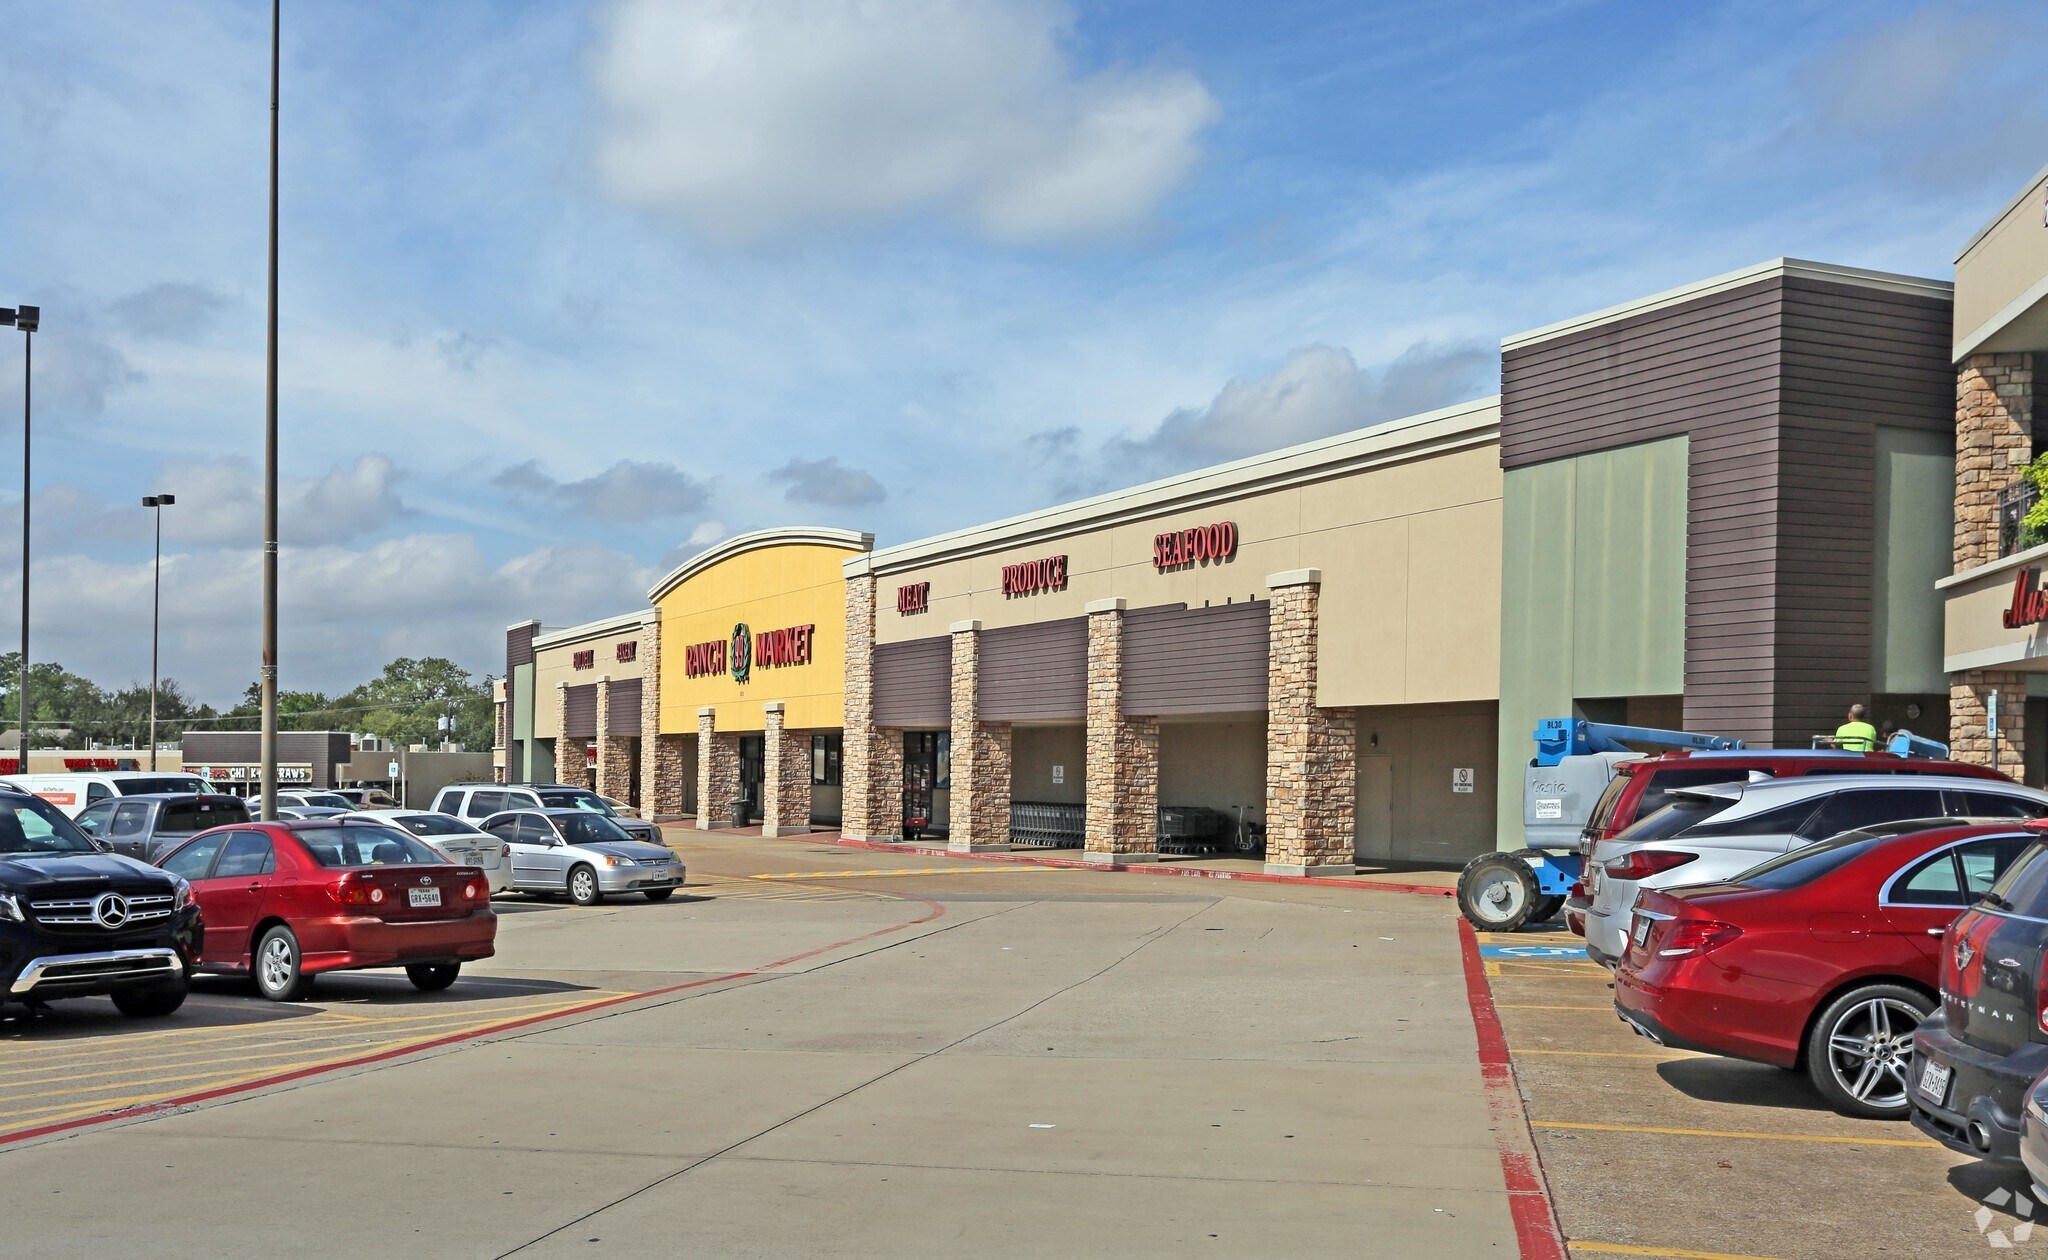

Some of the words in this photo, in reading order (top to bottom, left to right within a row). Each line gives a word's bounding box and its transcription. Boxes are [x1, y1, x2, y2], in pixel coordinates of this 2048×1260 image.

[1153, 521, 1236, 568] SEAFOOD
[1002, 554, 1066, 595] PRODUCE
[897, 582, 927, 612] MEAT
[685, 640, 725, 676] RANCH
[734, 635, 743, 668] 99
[756, 624, 814, 667] MARKET
[1547, 721, 1562, 729] BL30
[230, 767, 258, 778] CHIK
